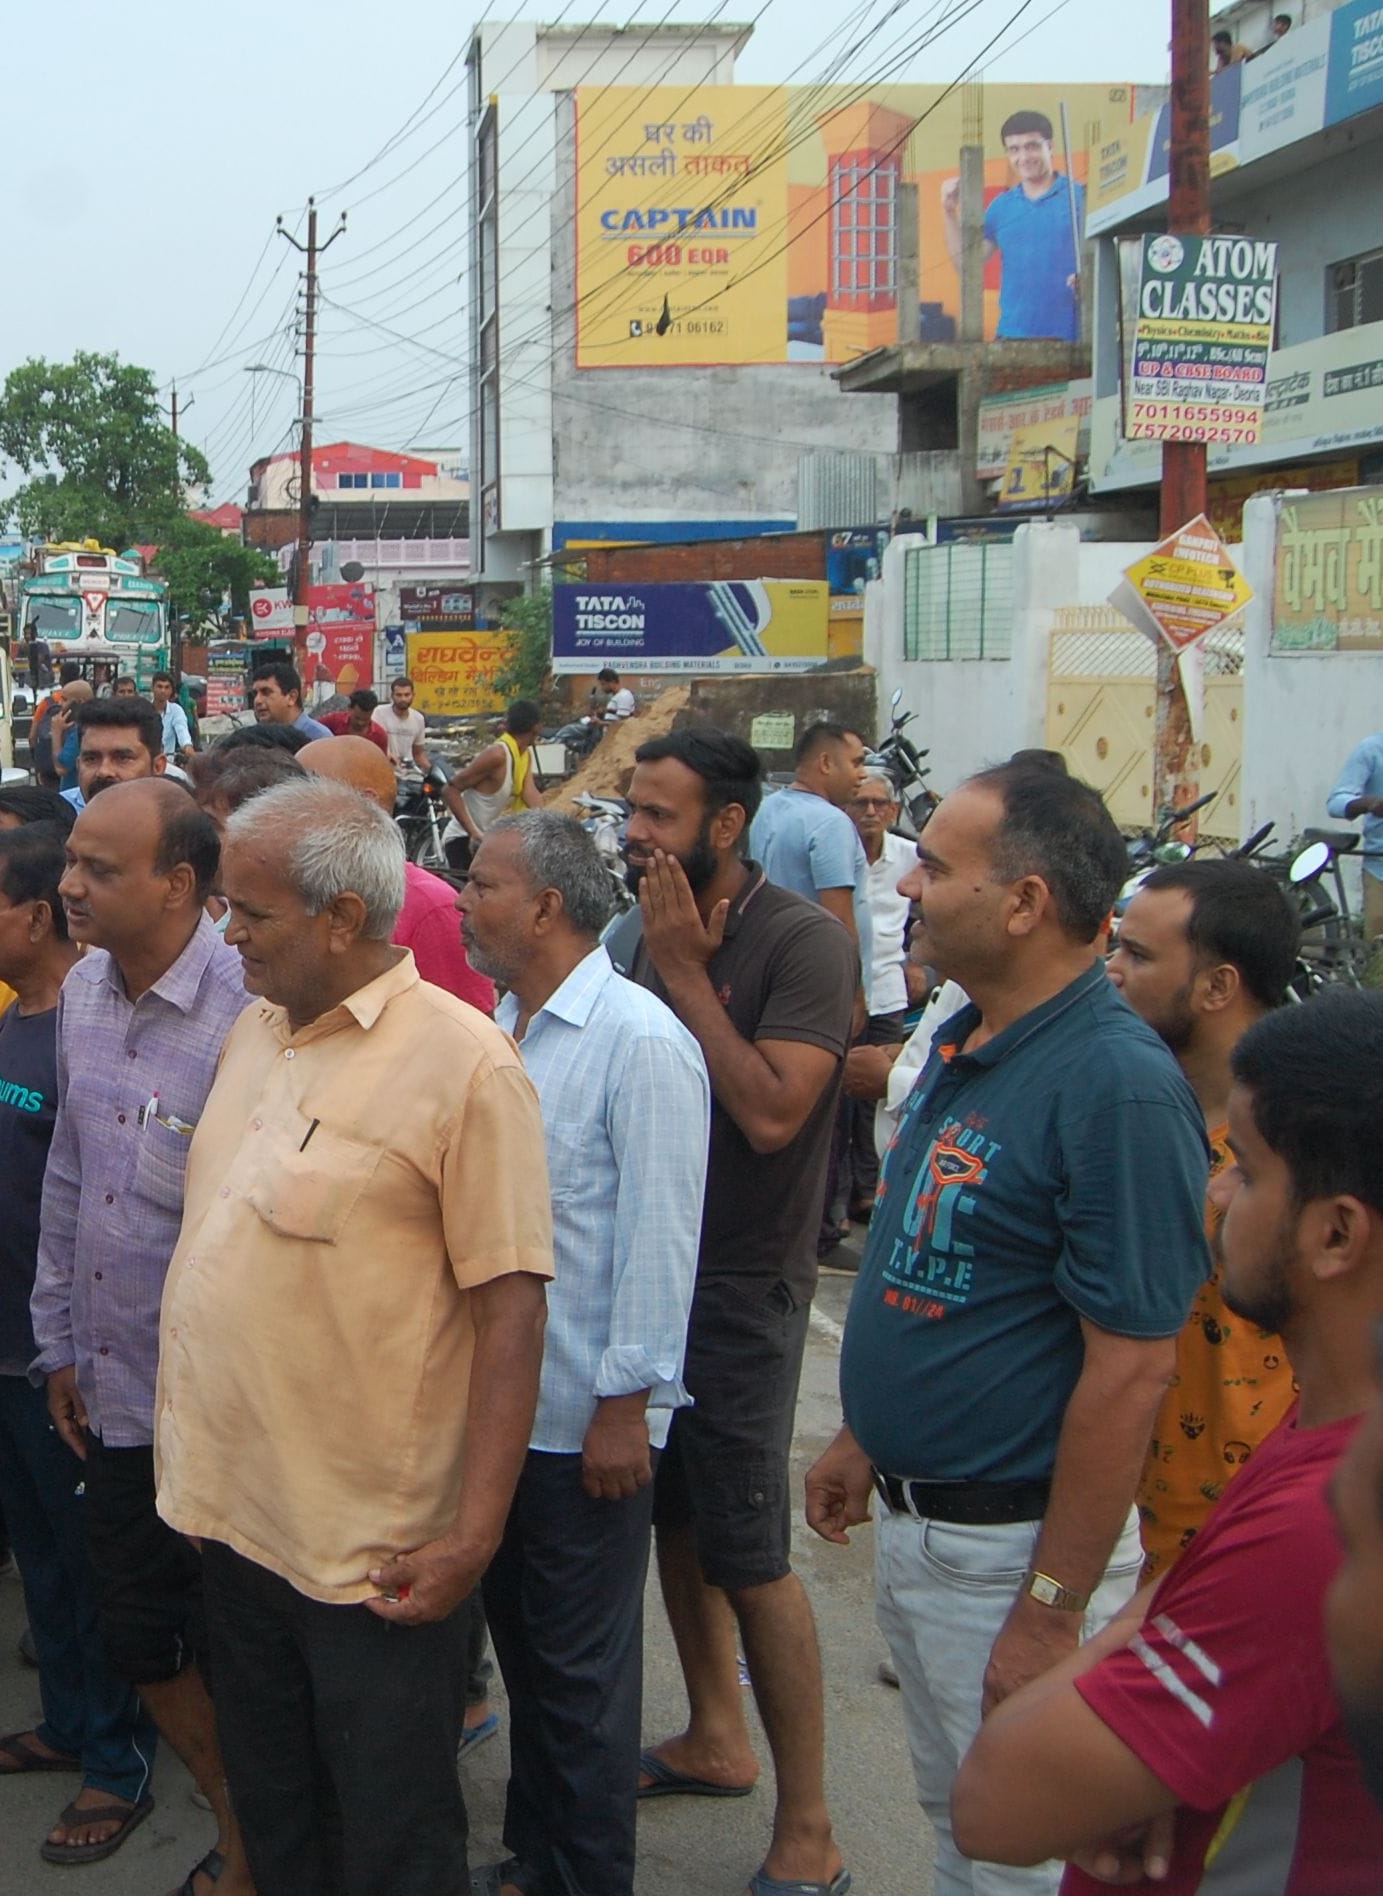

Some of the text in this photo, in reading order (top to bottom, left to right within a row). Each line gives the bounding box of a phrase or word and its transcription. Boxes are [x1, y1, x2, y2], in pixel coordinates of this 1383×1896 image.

[644, 115, 713, 144] घर की
[604, 147, 752, 177] असली ताकत
[600, 207, 757, 231] CAPTAIN
[627, 243, 729, 267] 600 EQR
[1193, 238, 1280, 281] ATOM
[1141, 279, 1273, 325] CLASSES
[687, 320, 724, 333] 06162
[1138, 361, 1263, 382] UP & CBSE BOARD
[1134, 378, 1154, 395] Near
[1133, 403, 1258, 425] 7011655994
[1131, 422, 1257, 444] 7572092570
[1281, 505, 1351, 613] वैभव
[575, 596, 627, 611] TATA
[575, 614, 645, 629] TISCON
[575, 638, 645, 647] JOY OF BUILDING
[682, 660, 721, 669] MATERIALS
